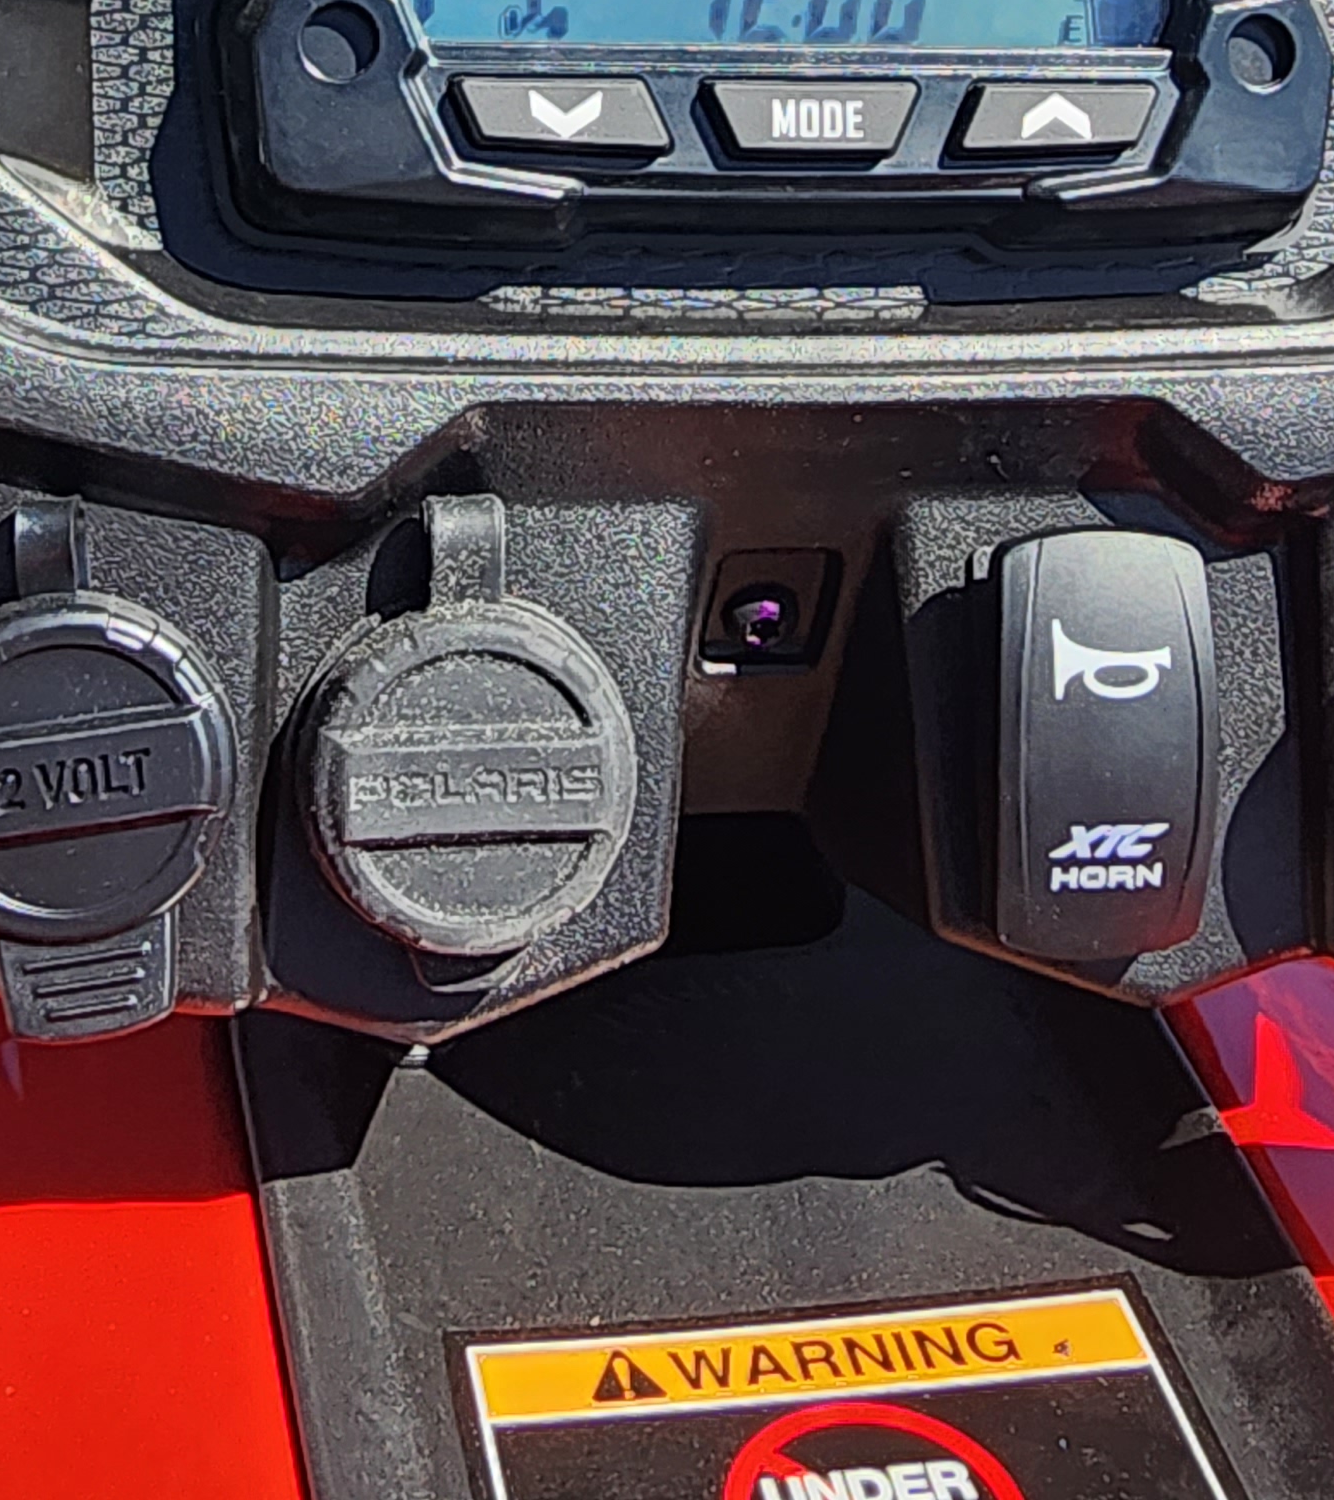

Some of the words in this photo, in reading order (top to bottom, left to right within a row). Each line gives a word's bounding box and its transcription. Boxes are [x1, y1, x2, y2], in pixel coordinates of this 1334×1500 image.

[771, 98, 865, 139] MODE
[34, 748, 151, 810] VOLT
[349, 764, 603, 811] POLARIS
[1048, 822, 1170, 859] XTC
[1050, 862, 1163, 892] HORN
[669, 1322, 1021, 1390] WARNING
[759, 1460, 980, 1500] UNDER
